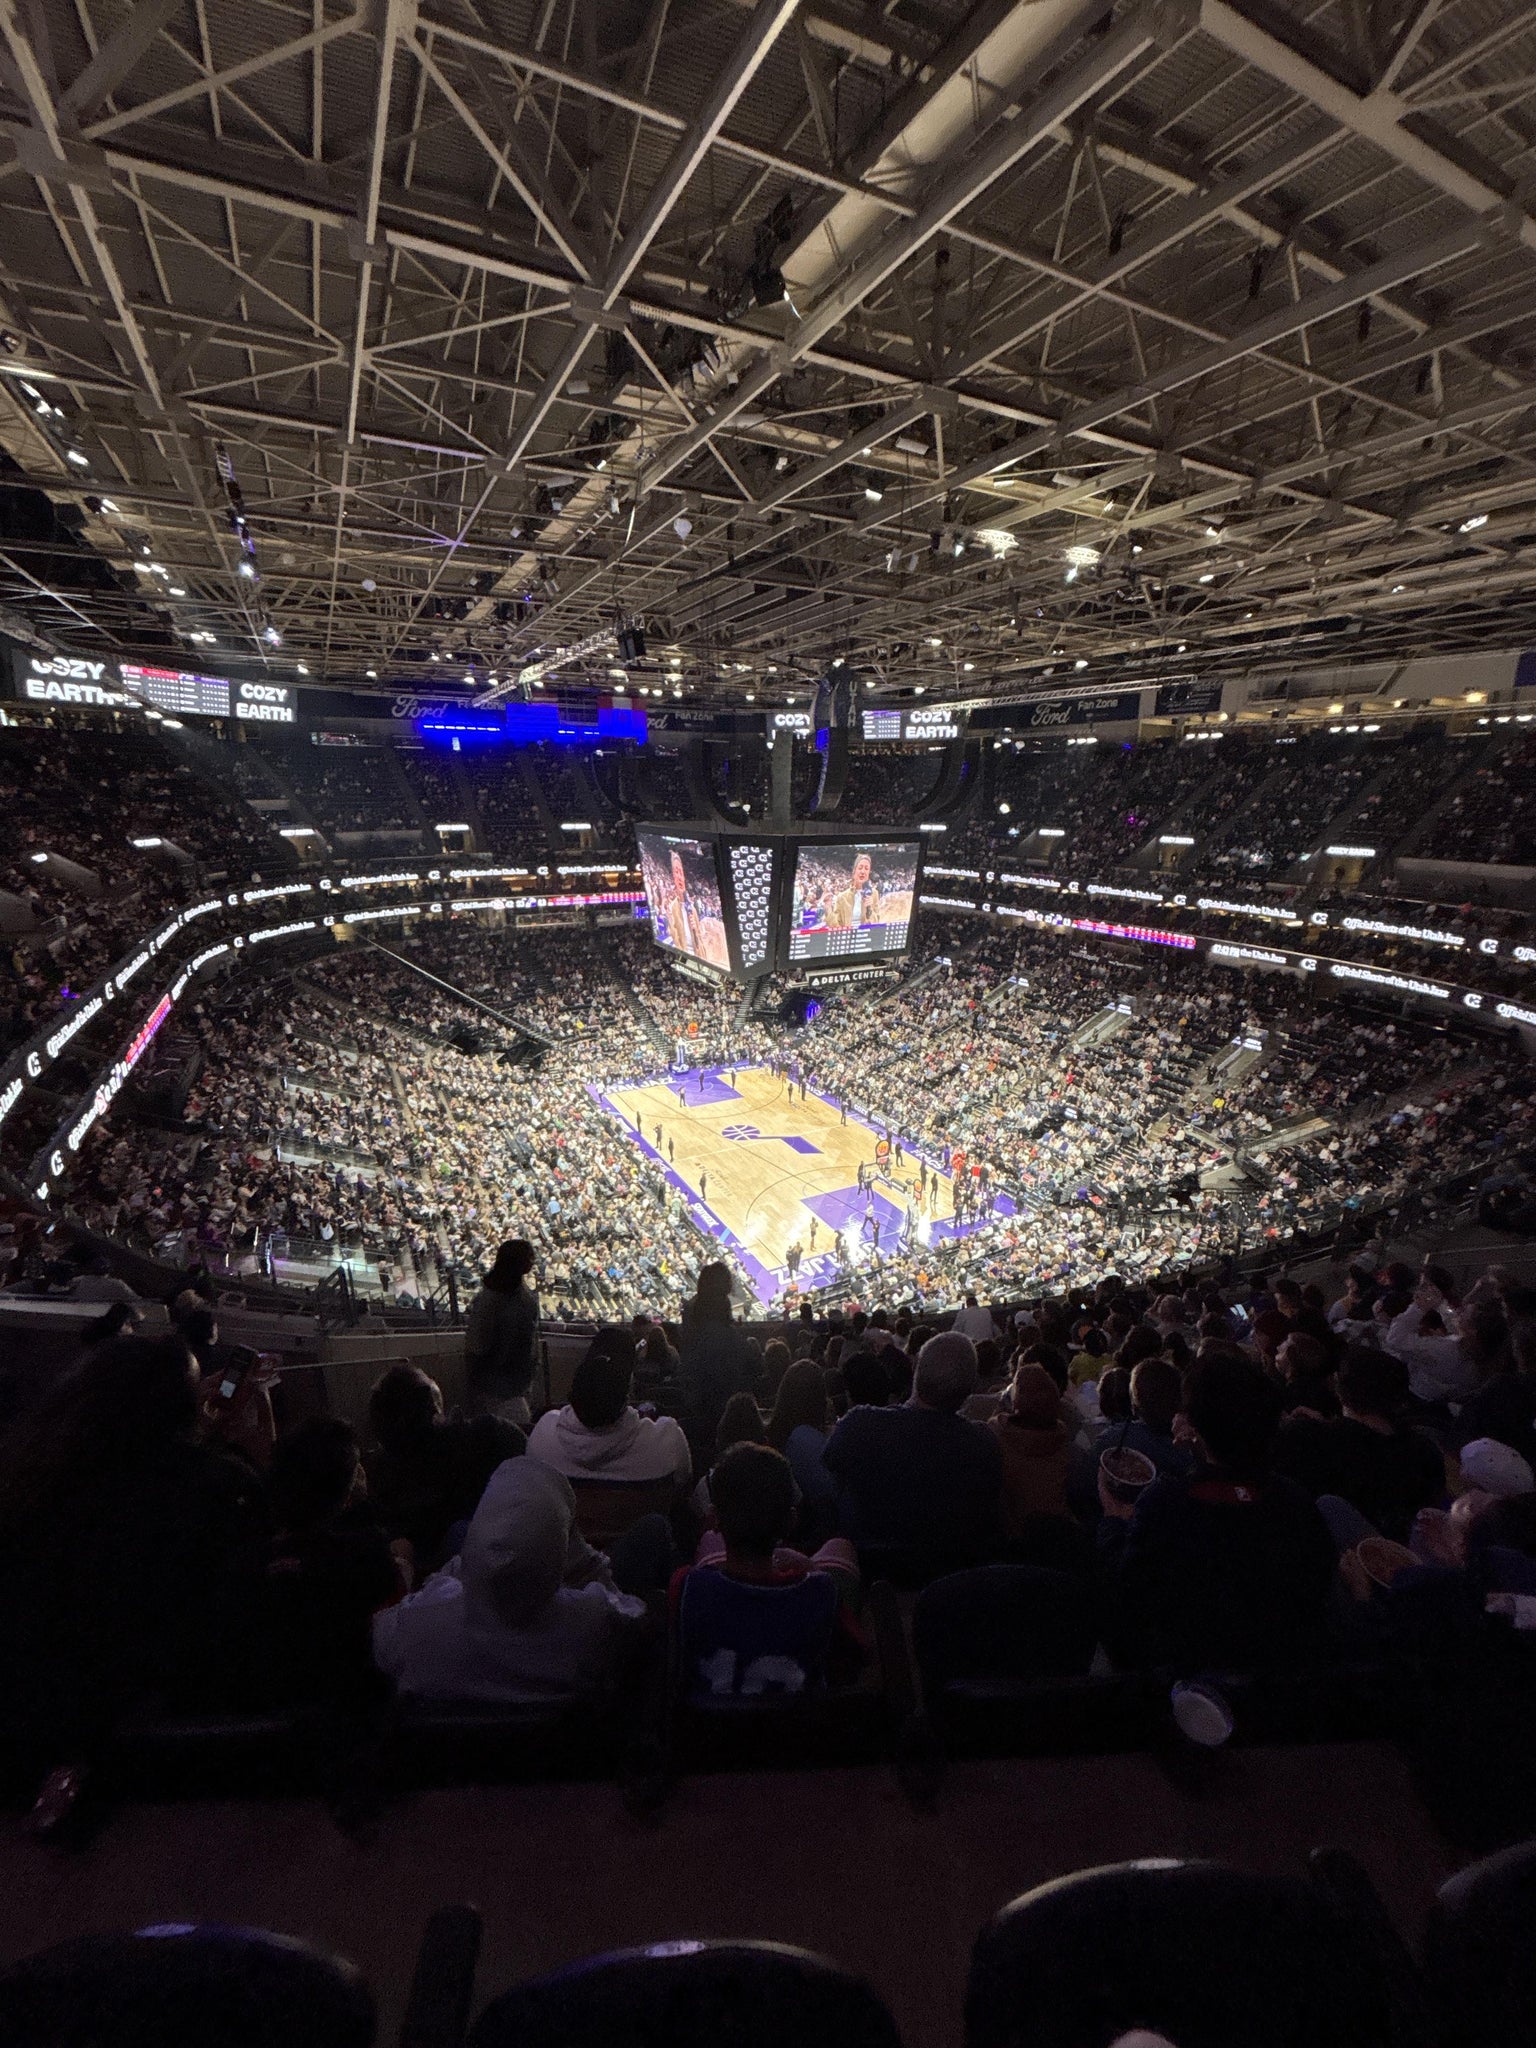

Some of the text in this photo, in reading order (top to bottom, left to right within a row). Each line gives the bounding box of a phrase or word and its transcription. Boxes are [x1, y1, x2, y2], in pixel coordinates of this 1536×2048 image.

[240, 683, 287, 701] COZY
[236, 703, 292, 722] EARTH
[391, 694, 448, 719] Ford
[1077, 698, 1119, 711] Fan Zone
[647, 714, 668, 729] rd
[910, 710, 952, 723] COZY
[1031, 702, 1073, 726] Ford
[905, 725, 957, 739] EARTH
[1262, 906, 1279, 918] Utah
[1343, 918, 1465, 946] Official Sheets of the Utah Jazz
[821, 970, 884, 984] DELTA CENTER
[1332, 962, 1360, 978] Official
[1385, 976, 1396, 986] of
[1396, 977, 1408, 988] the
[1409, 980, 1429, 993] Utah
[1430, 983, 1450, 998] Jazz
